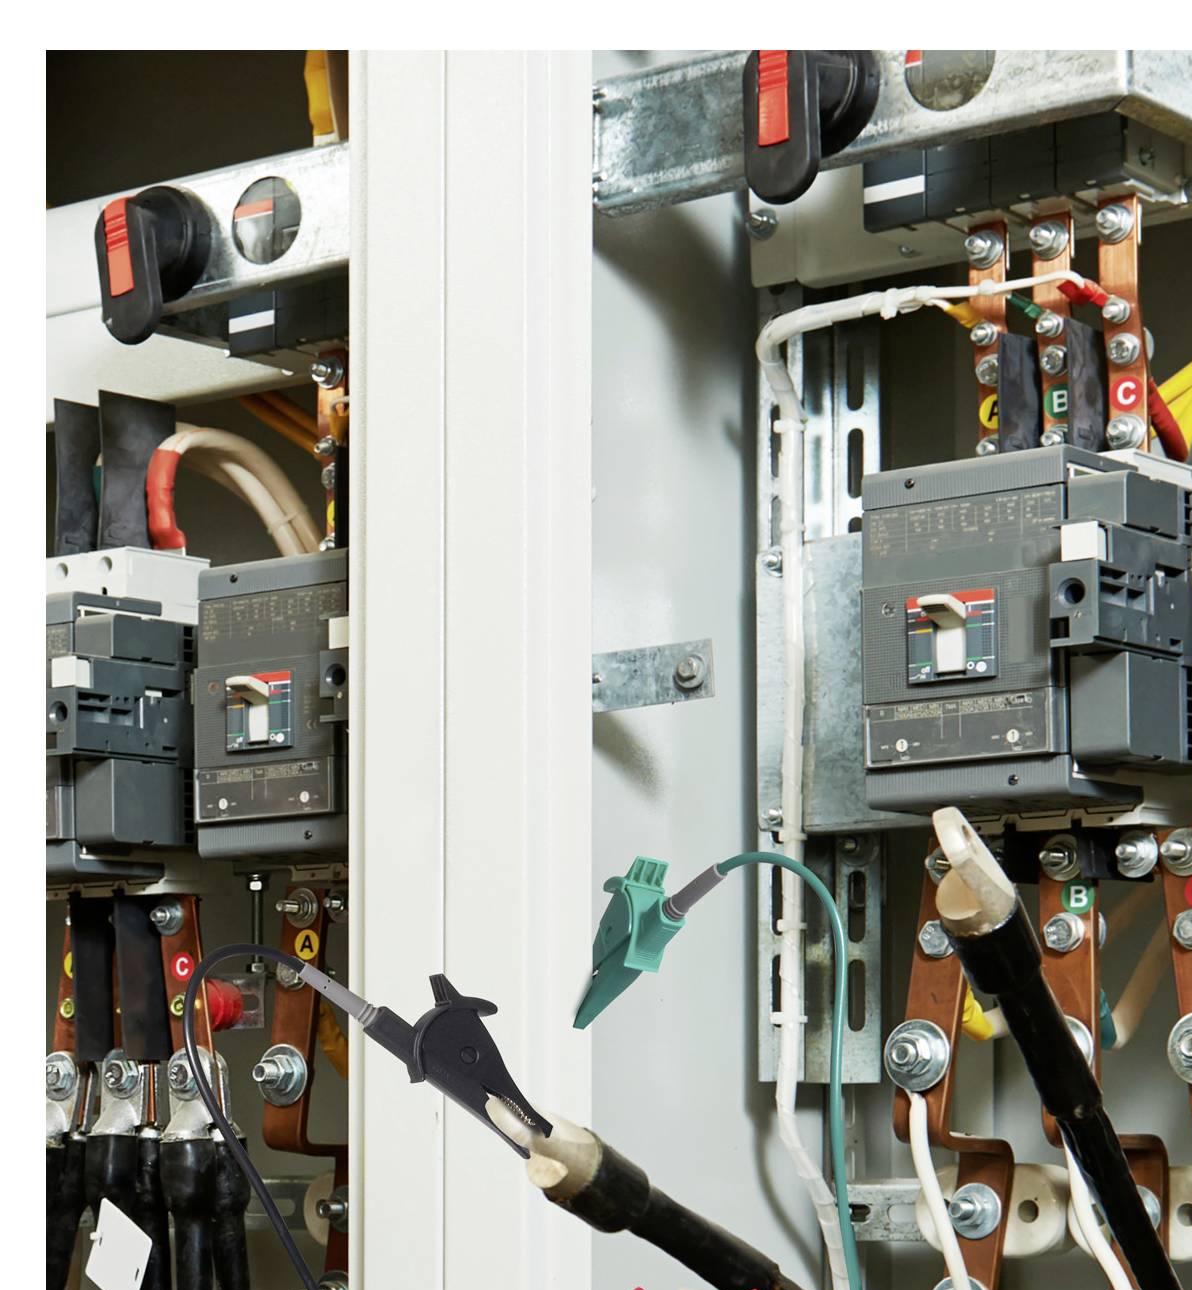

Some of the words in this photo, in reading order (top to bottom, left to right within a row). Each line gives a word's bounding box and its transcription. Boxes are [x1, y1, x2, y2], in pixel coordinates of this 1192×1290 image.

[1052, 390, 1068, 414] B
[1117, 381, 1137, 406] C
[1069, 885, 1087, 908] B
[300, 935, 313, 953] A
[174, 957, 190, 977] C
